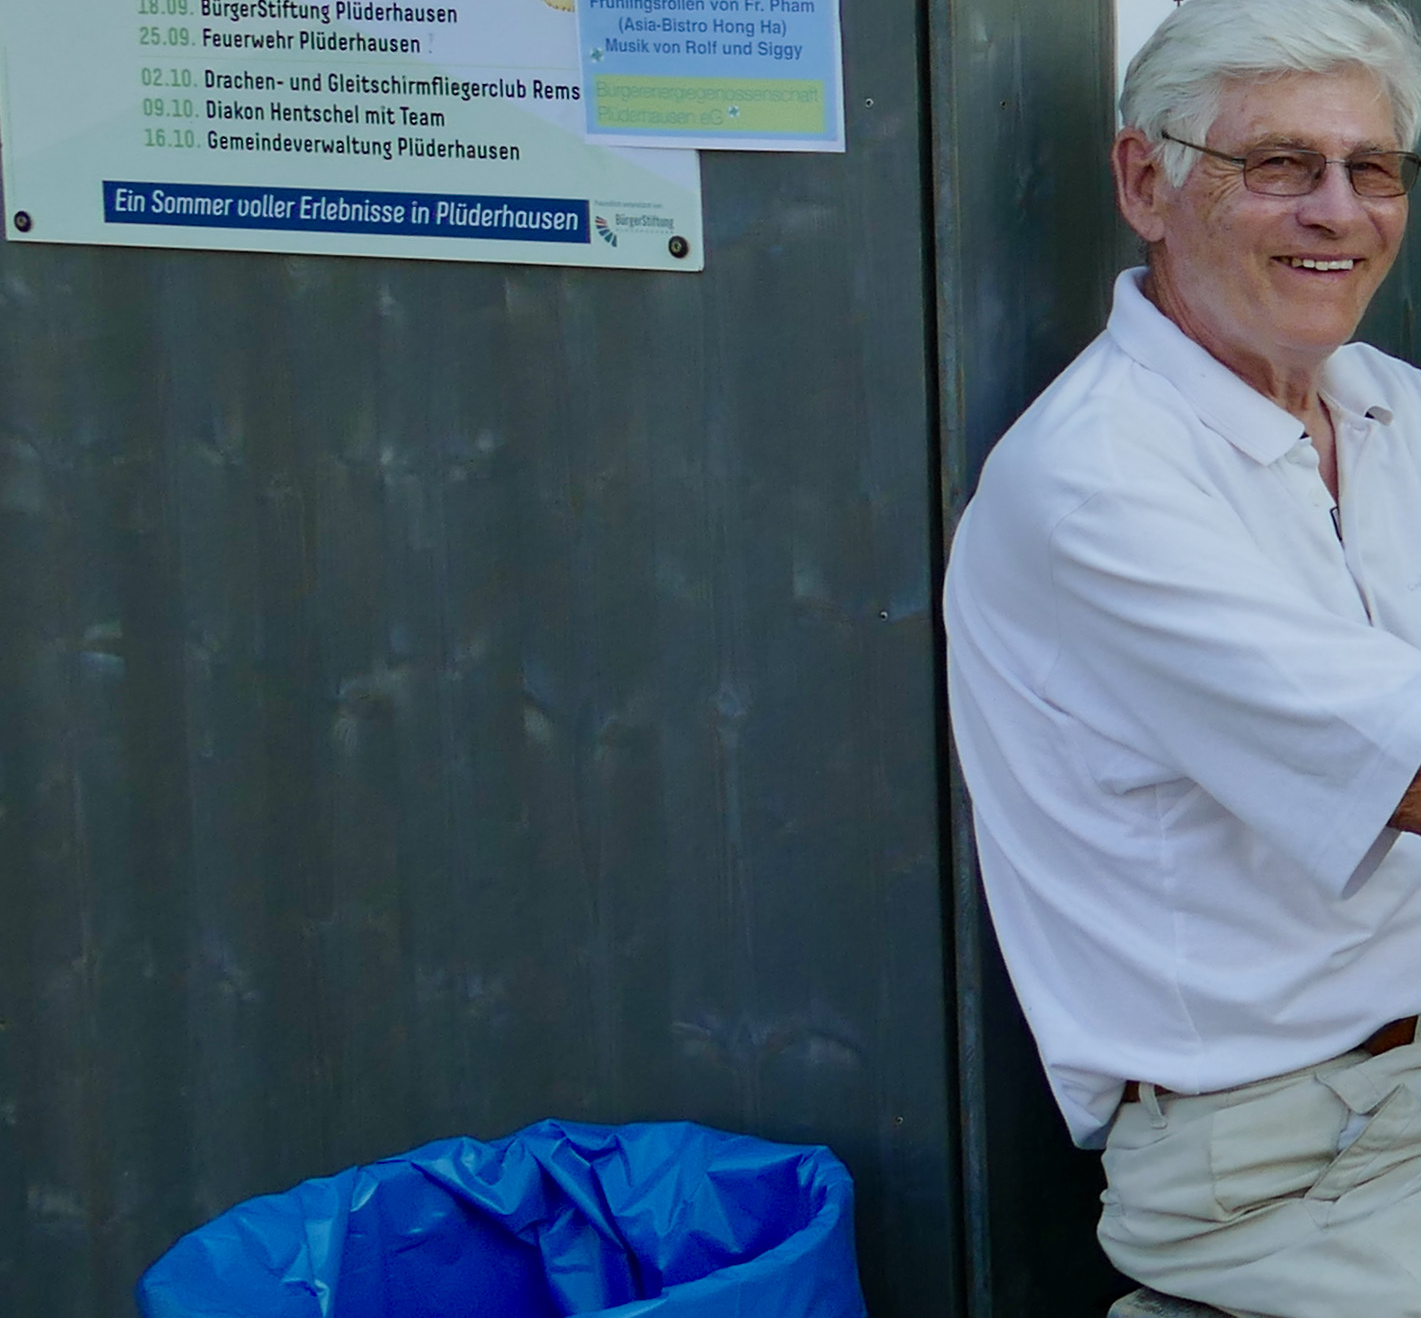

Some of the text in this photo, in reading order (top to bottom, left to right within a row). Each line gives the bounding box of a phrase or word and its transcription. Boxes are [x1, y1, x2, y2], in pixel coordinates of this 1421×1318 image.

[336, 1, 457, 23] Plüderhausen
[710, 0, 739, 11] von
[140, 26, 420, 53] 25.09. Feuerwehr Plüderhausen
[619, 17, 786, 37] (Asia-Bistro Hong Ha)
[605, 38, 802, 60] Musik von Rolf und Siggy
[141, 67, 580, 101] 02.10. Drachen- und Gleitschirmfliegerclub Rems
[143, 98, 444, 126] 09.10. Diakon Hentschel mit Team
[145, 128, 519, 160] 16.10. Gemeindeverwaltung Plüderhausen
[116, 189, 578, 230] Ein Sommer voller Erlebnisse in Plüderhausen
